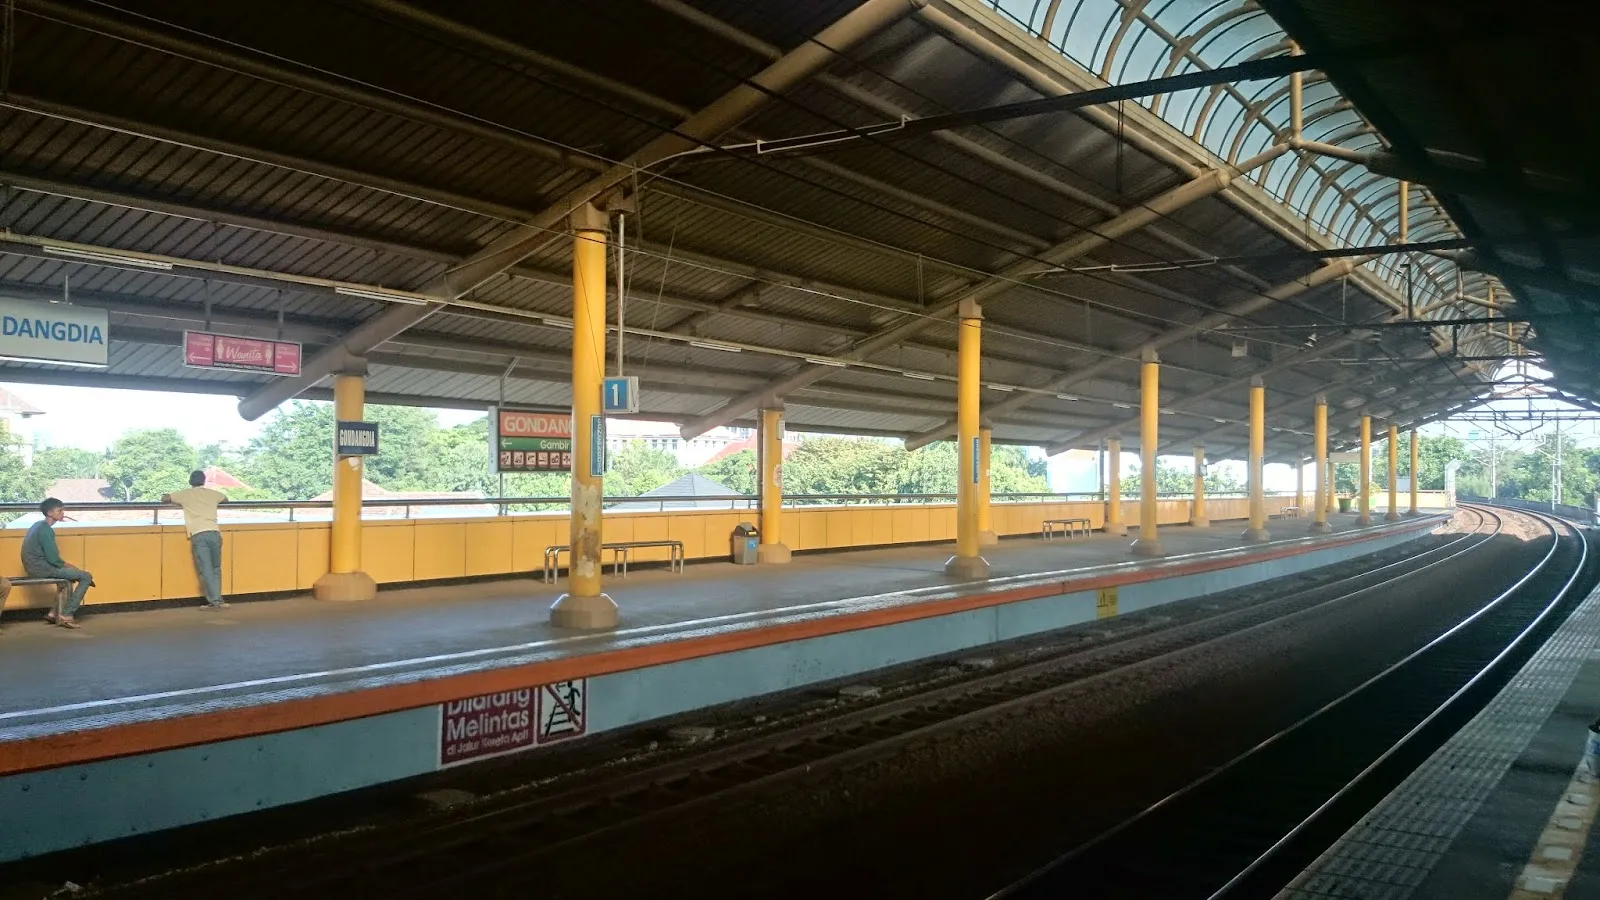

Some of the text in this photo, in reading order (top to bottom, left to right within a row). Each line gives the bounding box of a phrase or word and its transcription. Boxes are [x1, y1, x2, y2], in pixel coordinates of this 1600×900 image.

[0, 316, 103, 345] DANGDIA
[226, 345, 263, 361] Wanita
[611, 383, 619, 406] 1
[540, 440, 570, 450] Gambir
[447, 709, 529, 741] Melintas
[457, 741, 479, 753] Jalur
